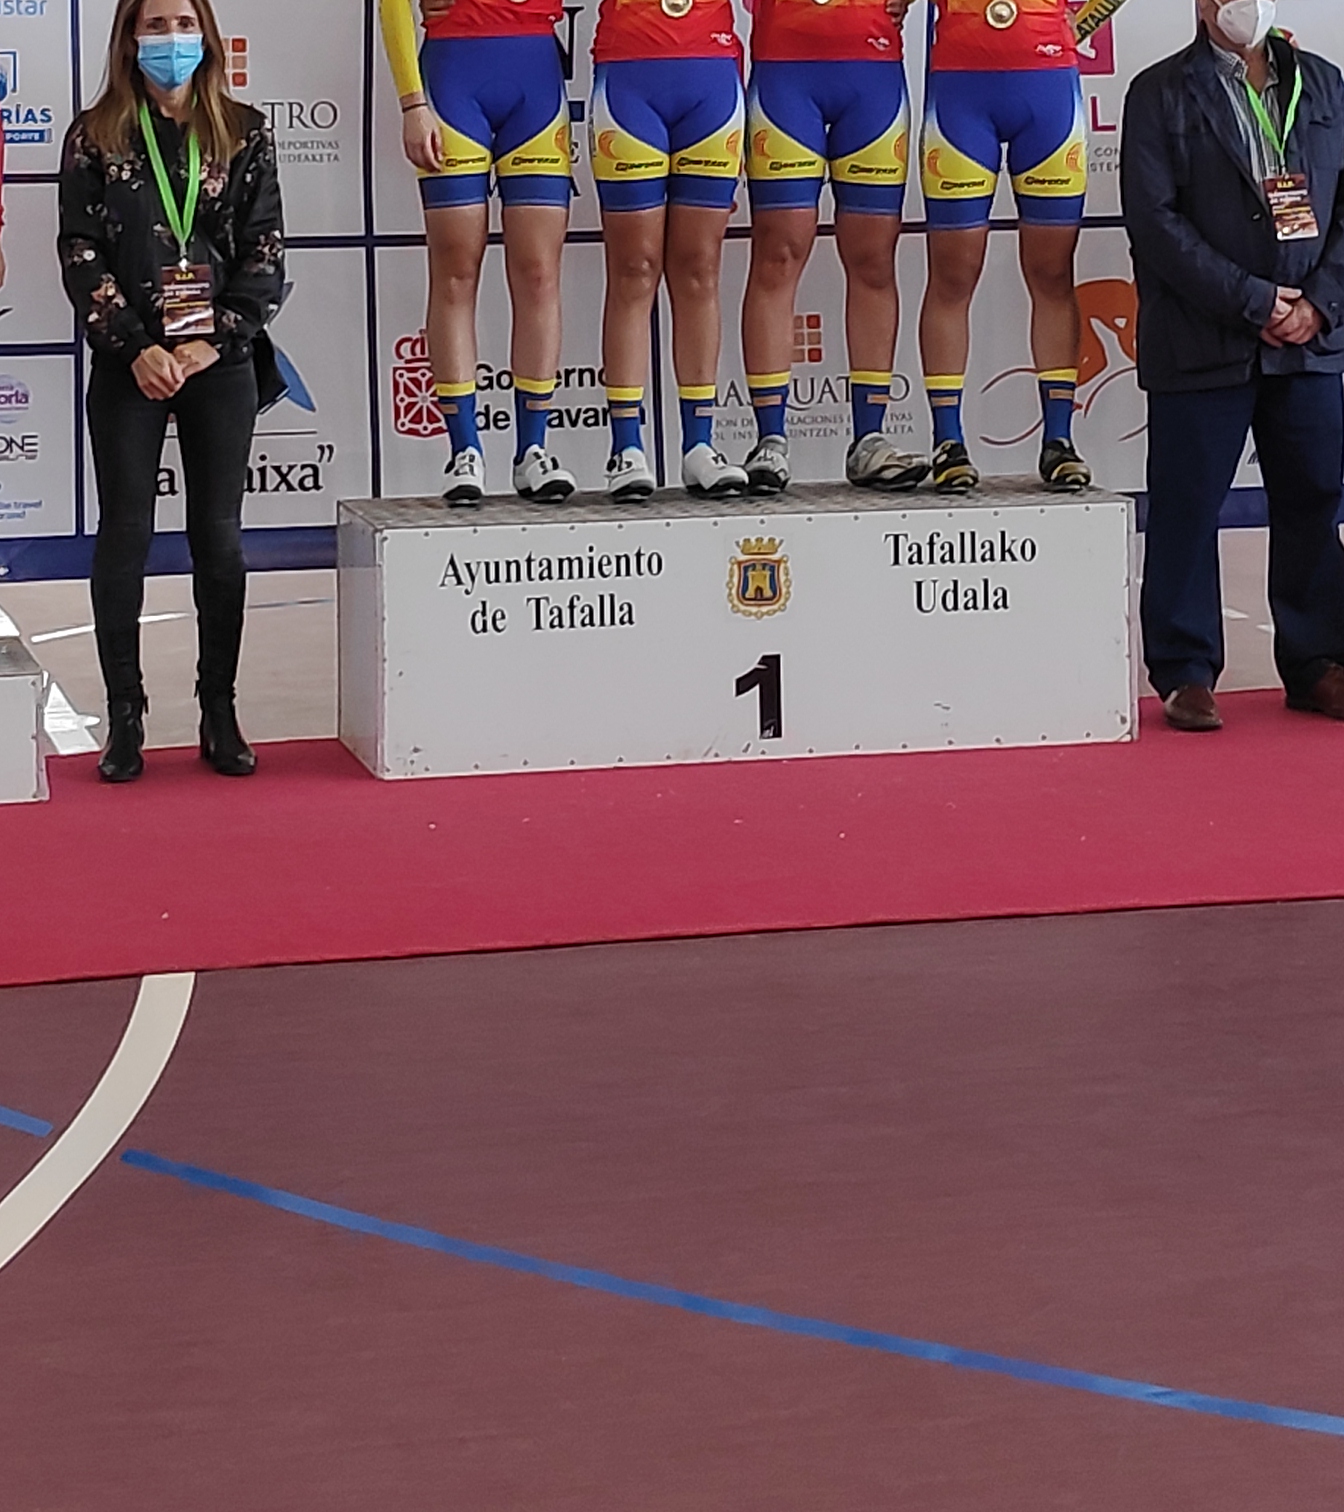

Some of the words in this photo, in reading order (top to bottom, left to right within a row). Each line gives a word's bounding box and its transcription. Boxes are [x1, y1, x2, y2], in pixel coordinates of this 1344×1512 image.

[279, 153, 340, 163] UDEAKETA
[475, 404, 510, 431] de
[884, 530, 1038, 567] Tafallako
[439, 545, 664, 594] Ayuntamiento
[470, 601, 506, 634] de
[527, 592, 636, 632] Tafalla
[913, 578, 1010, 615] Udala
[735, 654, 784, 739] 1
